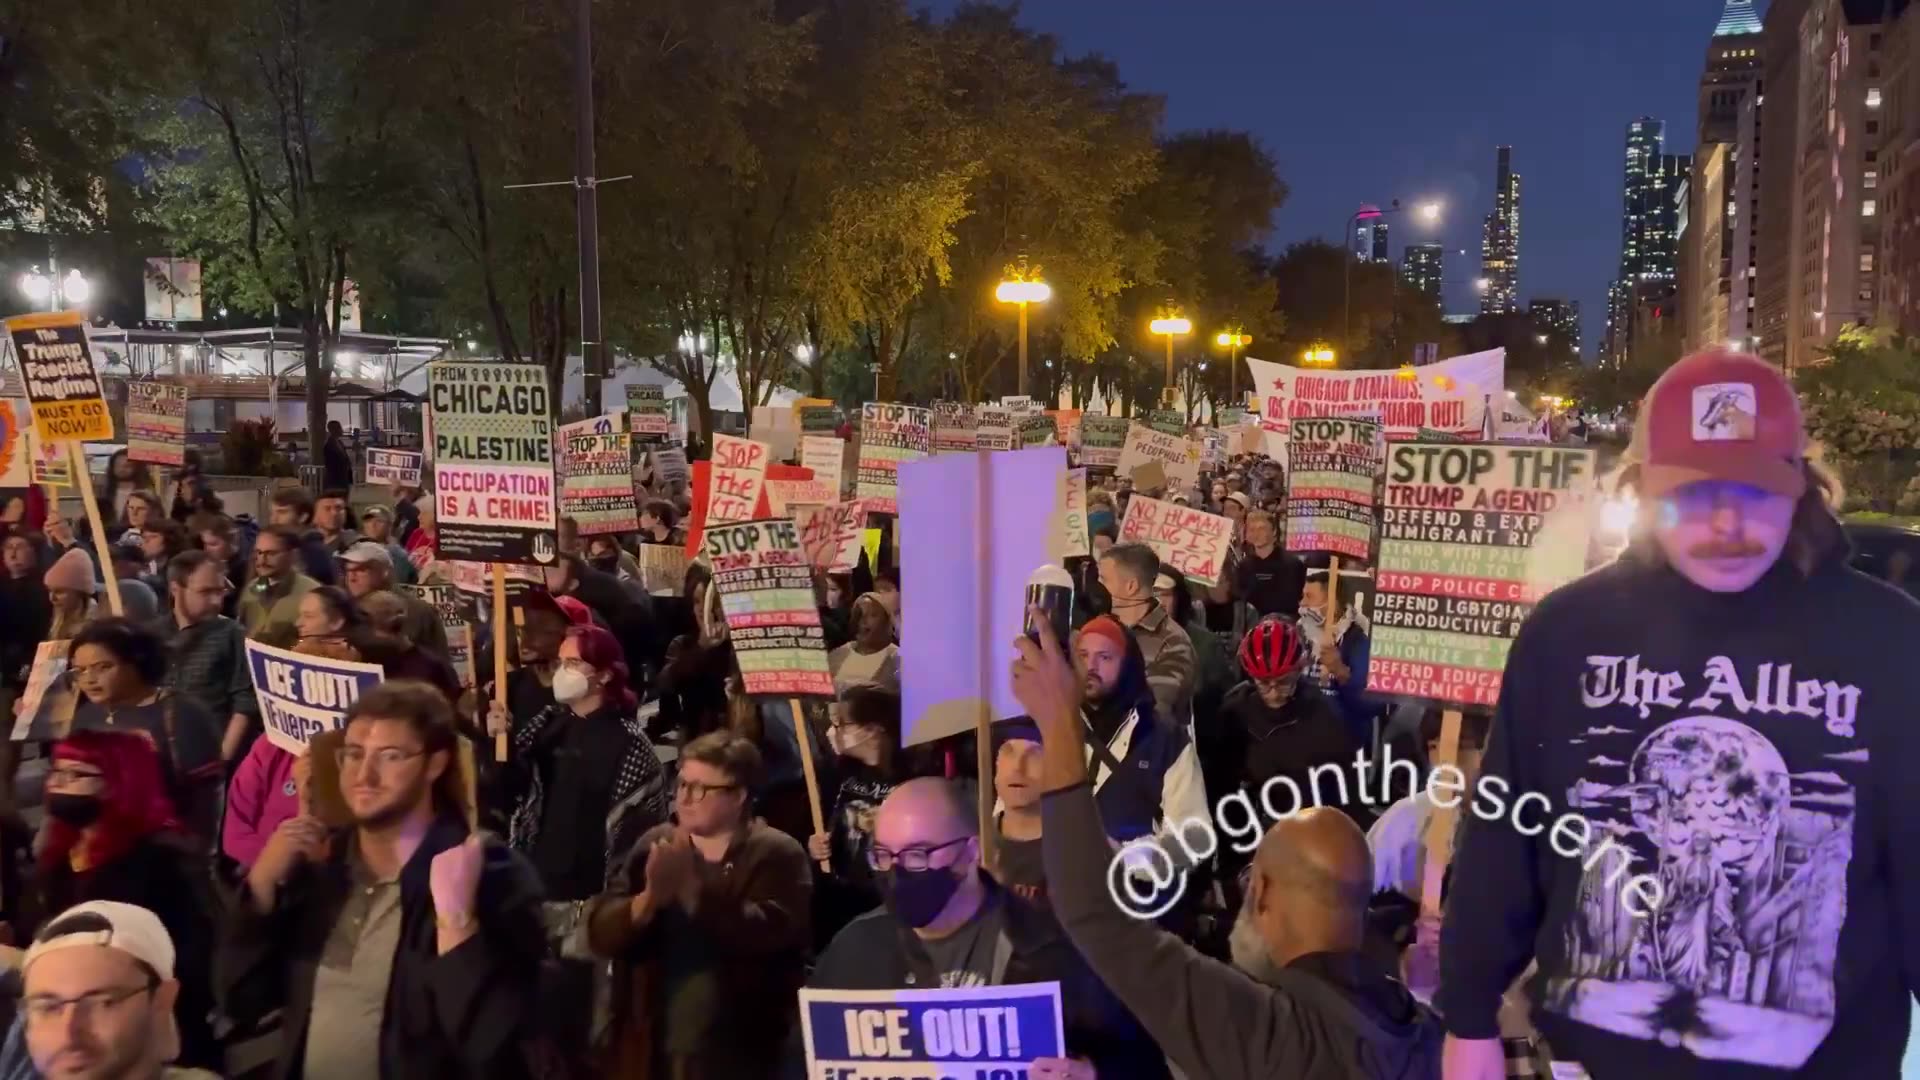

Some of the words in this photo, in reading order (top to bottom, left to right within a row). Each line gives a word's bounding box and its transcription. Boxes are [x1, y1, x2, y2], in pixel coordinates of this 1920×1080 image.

[36, 329, 60, 344] The
[22, 342, 83, 361] Trump
[433, 368, 467, 382] FROM
[29, 379, 97, 401] Regime
[130, 384, 162, 398] STOP
[166, 386, 186, 401] THE
[627, 390, 664, 400] CHICAGO
[1294, 376, 1350, 402] CHICAGO
[1353, 374, 1423, 401] DEMANDS:
[433, 383, 547, 416] CHICAGO
[935, 404, 958, 416] STOP
[961, 404, 975, 416] THE
[37, 405, 75, 420] MUST
[864, 403, 906, 422] STOP
[908, 407, 928, 426] THE
[1152, 413, 1183, 425] CHICAGO
[1380, 401, 1425, 428] GUARD
[1430, 401, 1464, 428] OUT!
[532, 420, 548, 436] TO
[863, 420, 896, 432] TRUMP
[1292, 421, 1345, 442] STOP
[1350, 424, 1375, 446] THE
[437, 435, 550, 462] PALESTINE
[568, 434, 598, 453] STOP
[601, 434, 628, 452] THE
[715, 440, 763, 468] STOP
[993, 440, 1009, 448] CITY
[1135, 442, 1187, 465] PEDOPHILES
[1292, 442, 1331, 454] TRUMP
[1291, 453, 1330, 464] DEFEND
[1291, 463, 1345, 472] IMMIGRANT
[1391, 446, 1495, 484] STOP
[439, 471, 550, 497] OCCUPATION
[715, 471, 753, 496] the
[1287, 499, 1320, 509] DEFEND
[1388, 484, 1464, 508] TRUMP
[1472, 488, 1556, 513] AGEND
[440, 496, 458, 516] IS
[467, 497, 479, 518] A
[487, 498, 550, 523] CRIME!
[1130, 500, 1157, 519] NO
[1164, 508, 1223, 534] HUMAN
[1286, 506, 1347, 518] REPRODUCTIVE
[1384, 508, 1462, 528] DEFEND
[1474, 512, 1486, 528] &
[1500, 514, 1542, 531] EXP
[706, 527, 760, 556] STOP
[765, 522, 800, 550] THE
[1122, 520, 1181, 545] BEING
[1187, 533, 1217, 554] IS
[1382, 523, 1497, 545] IMMIGRANT
[1383, 543, 1433, 557] STAND
[1443, 546, 1482, 561] WITH
[712, 554, 752, 572] TRUMP
[1419, 560, 1439, 572] US
[1450, 561, 1479, 575] AID
[1487, 564, 1508, 577] TO
[1376, 574, 1423, 591] STOP
[1431, 579, 1497, 595] POLICE
[430, 588, 450, 603] TH
[1374, 593, 1439, 613] DEFEND
[1373, 609, 1503, 635] REPRODUCTIVE
[1371, 627, 1421, 644] DEFEND
[1370, 643, 1461, 662] UNIONIZE
[263, 658, 298, 701] ICE
[1368, 659, 1434, 679] DEFEND
[1442, 667, 1502, 687] EDUCA
[1366, 675, 1464, 698] ACADEMIC
[1579, 653, 1686, 719] The
[1688, 655, 1862, 738] Alley
[843, 1008, 913, 1058] ICE
[920, 1005, 1022, 1058] OUT!
